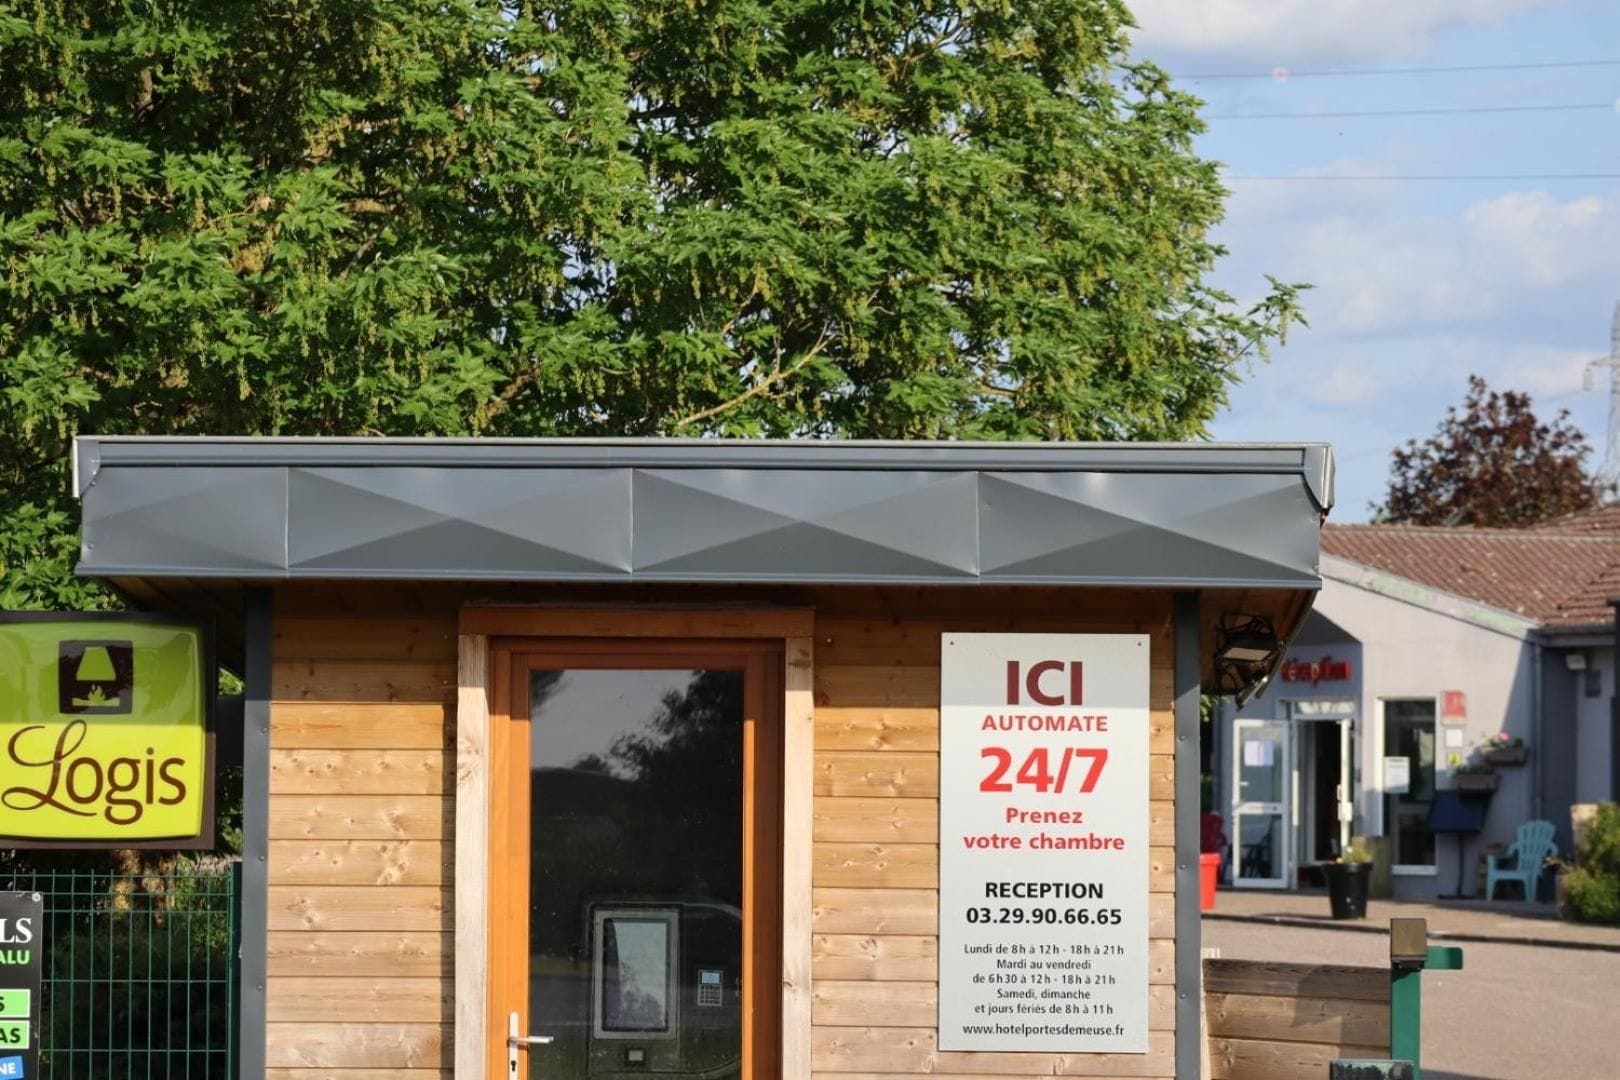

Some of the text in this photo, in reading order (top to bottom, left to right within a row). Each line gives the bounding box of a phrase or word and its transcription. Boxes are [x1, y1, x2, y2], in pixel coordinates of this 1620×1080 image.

[1006, 660, 1083, 706] ICI
[981, 715, 1108, 732] AUTOMATE
[1, 719, 186, 825] Logis
[979, 747, 1109, 794] 24/7
[1006, 807, 1083, 824] Prenez
[963, 832, 1125, 850] votre chambre
[985, 882, 1103, 899] RECEPTION
[966, 907, 1122, 925] 03.29.90.66.65
[964, 944, 993, 954] Lundi
[995, 944, 1009, 954] de
[1029, 944, 1036, 954] à
[1093, 945, 1100, 955] à
[996, 959, 1091, 970] Mardi au vendredi
[972, 974, 986, 984] de
[1020, 974, 1027, 984] à
[1084, 974, 1091, 985] à
[996, 989, 1091, 1001] Samedi, dimanche
[974, 1004, 985, 1014] et
[988, 1004, 1014, 1016] jours
[1016, 1003, 1047, 1014] fériés
[1049, 1004, 1062, 1014] de
[1082, 1004, 1089, 1014] à
[962, 1024, 1125, 1038] www.hotelportesdemeuse.fr
